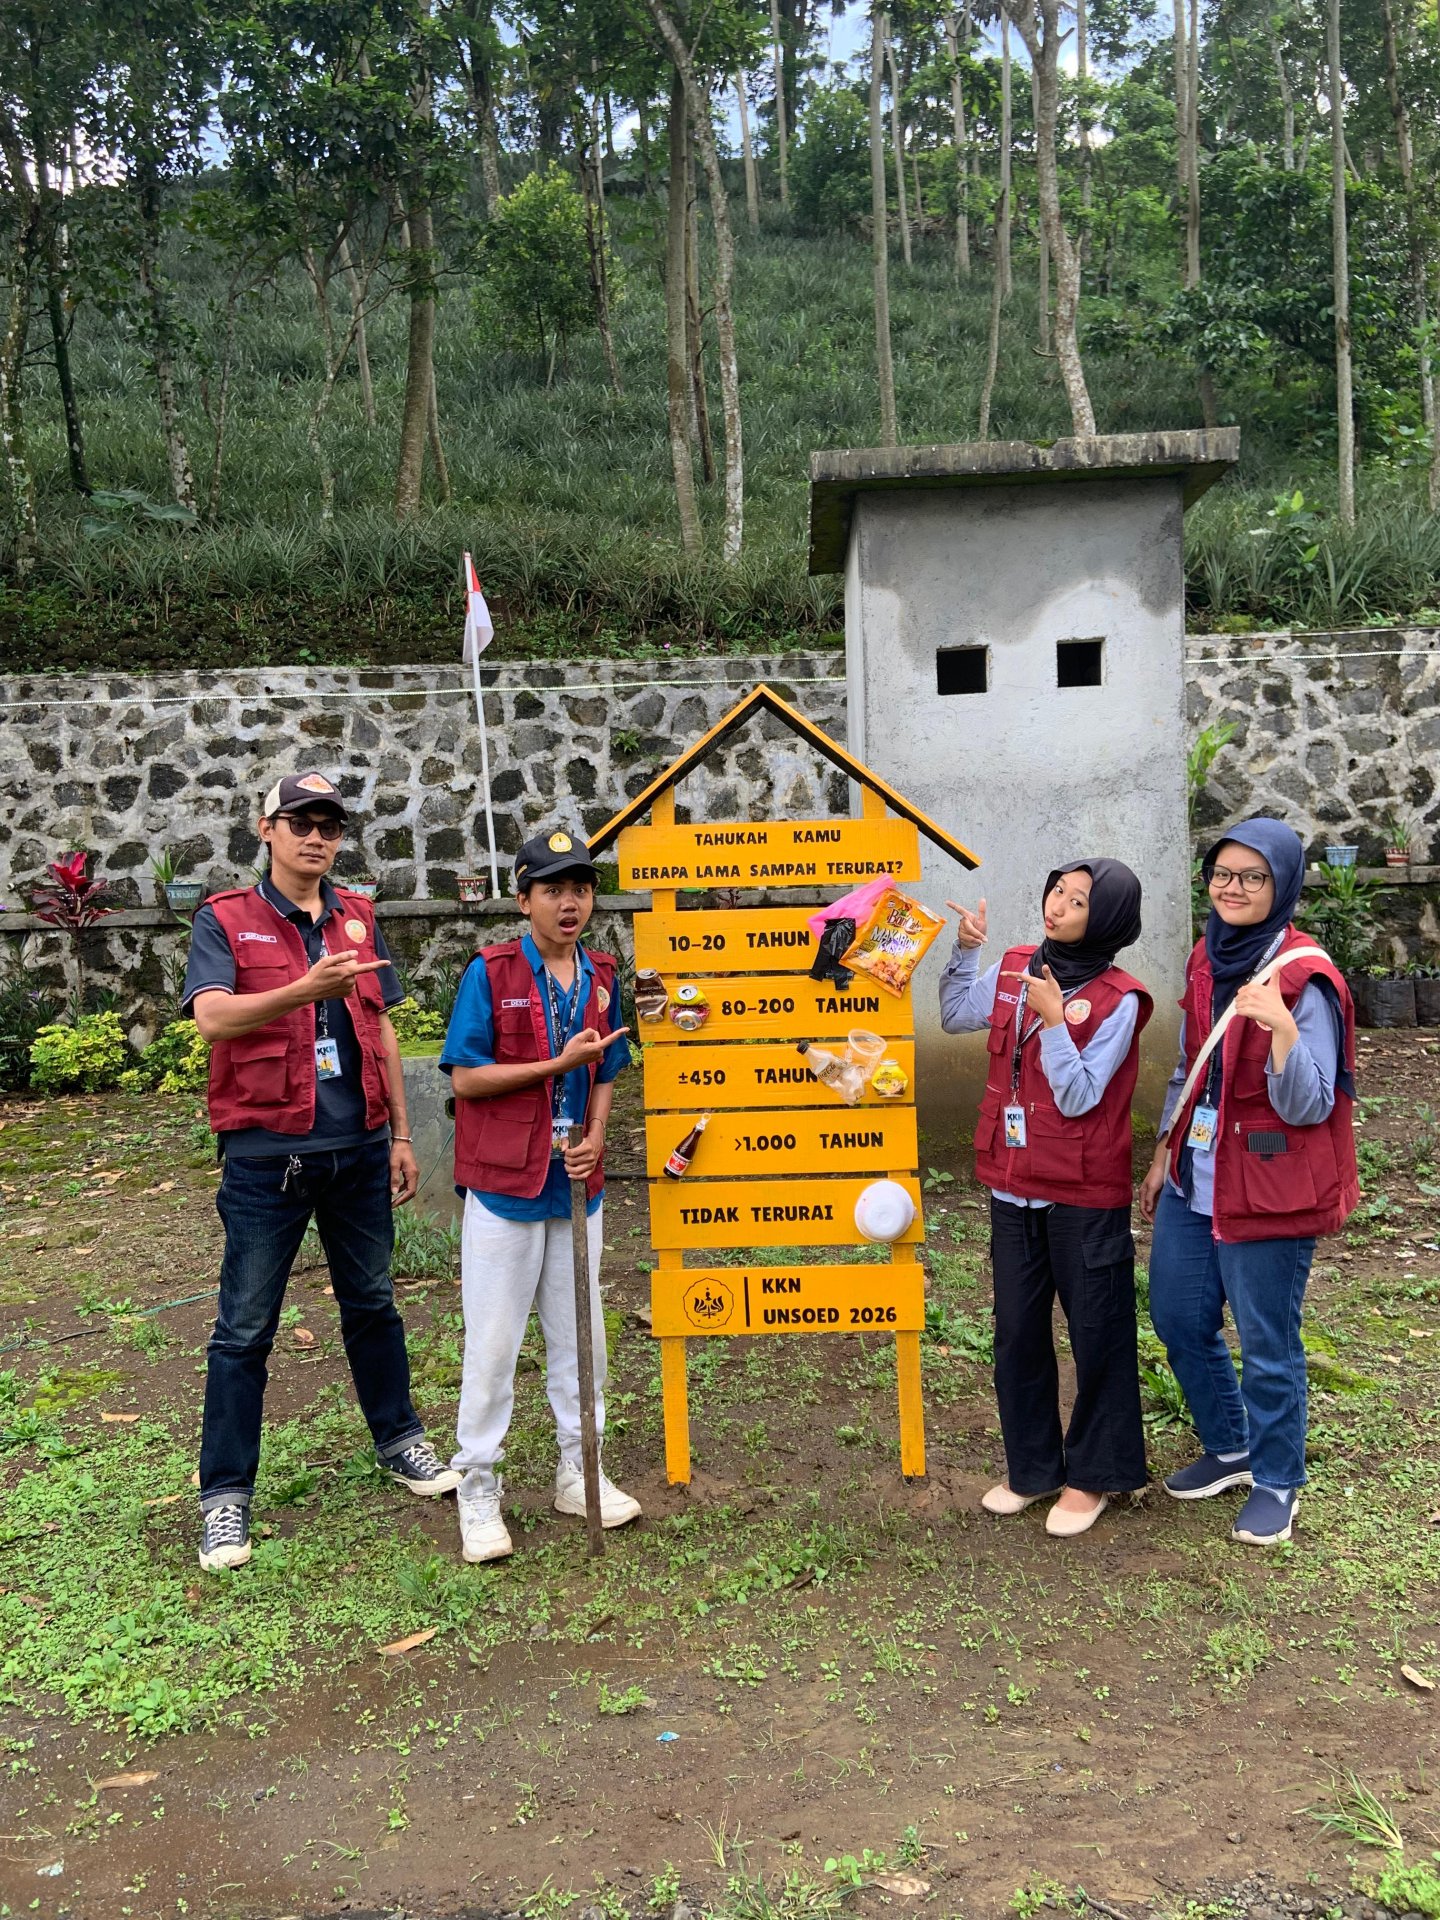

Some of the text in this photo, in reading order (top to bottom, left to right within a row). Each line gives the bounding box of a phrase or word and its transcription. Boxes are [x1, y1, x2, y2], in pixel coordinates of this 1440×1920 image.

[694, 829, 842, 847] TAHUKAH KAMU
[631, 860, 904, 880] BERAPA LAMA SAMPAH TERURAI?
[668, 930, 810, 952] 10-20 TAHUN
[721, 996, 880, 1016] 80-200 TAHUN
[678, 1067, 818, 1086] ±450 TAHUN
[734, 1131, 884, 1152] >1.000 TAHUN
[679, 1204, 835, 1225] TIDAK TERURAI
[762, 1277, 802, 1294] KKN
[763, 1306, 898, 1325] UNSOED 2026
